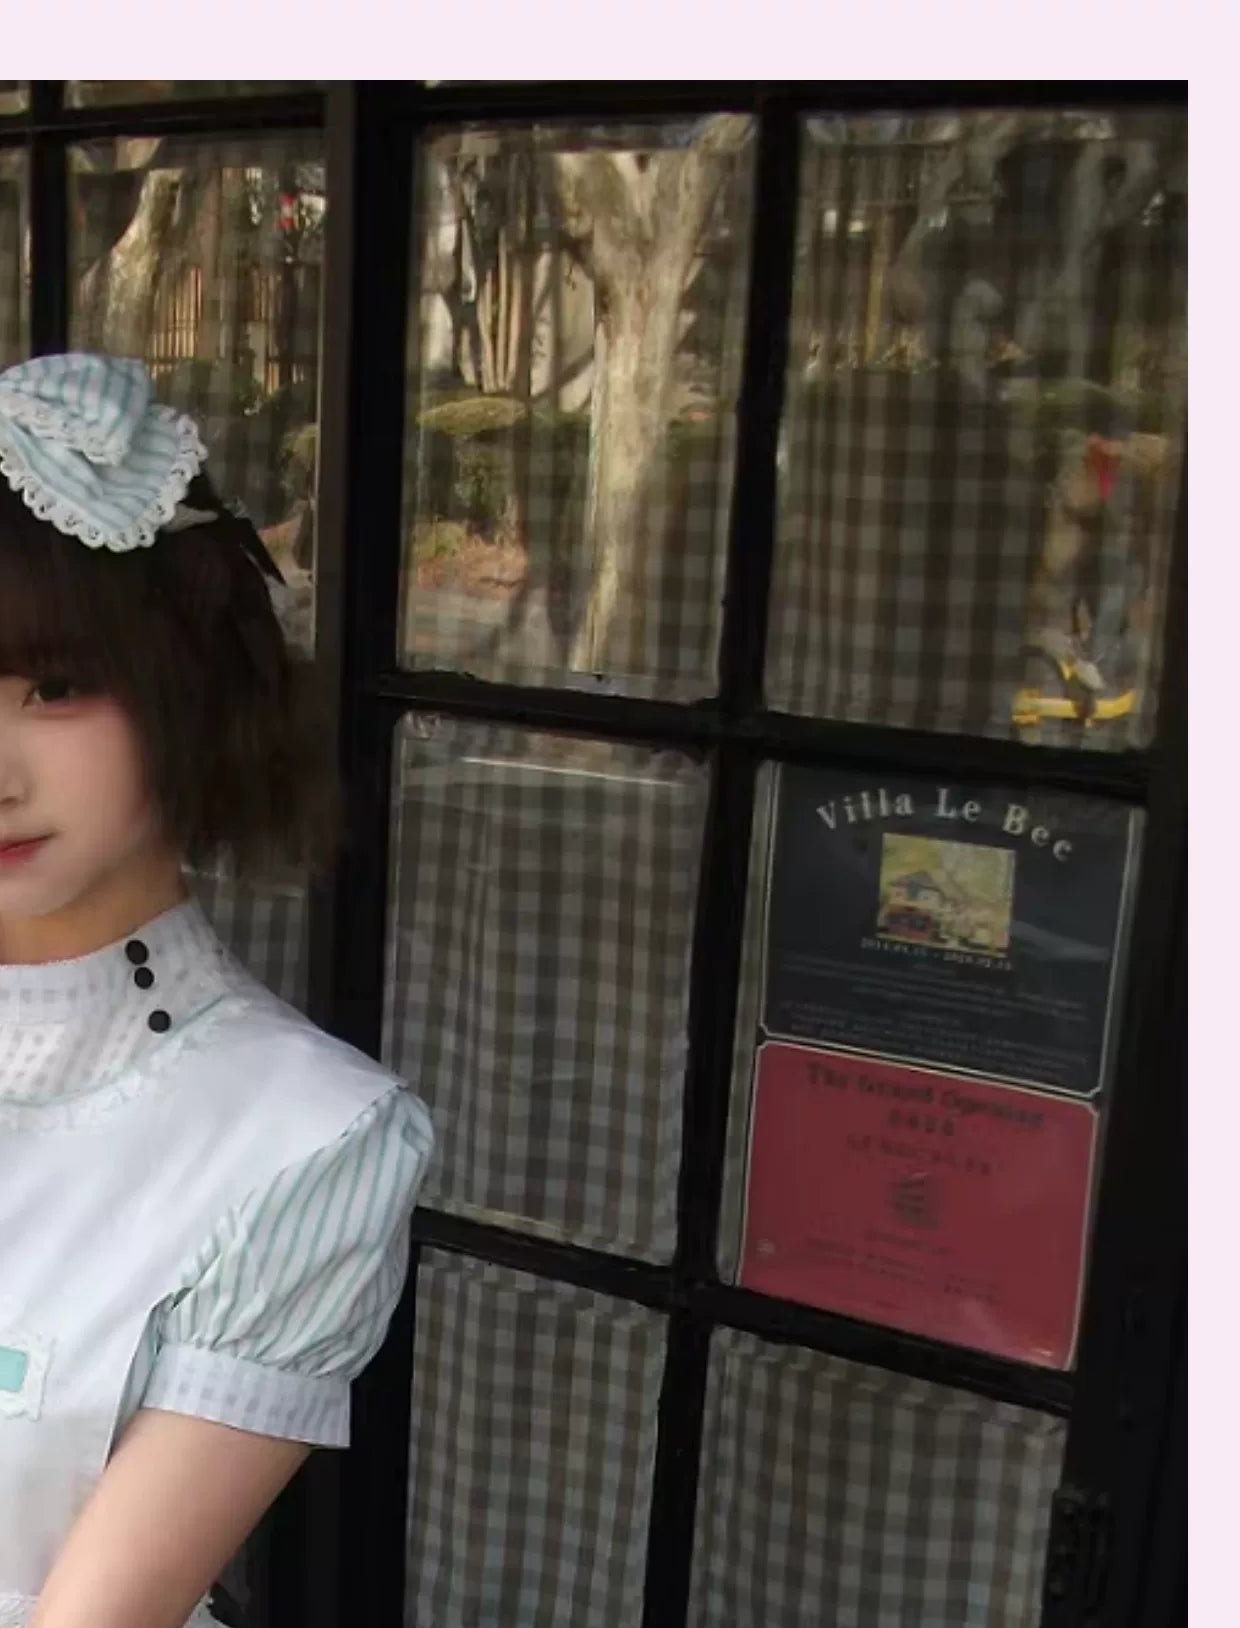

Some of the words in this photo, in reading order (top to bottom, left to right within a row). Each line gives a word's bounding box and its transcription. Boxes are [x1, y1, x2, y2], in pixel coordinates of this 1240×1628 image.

[815, 787, 915, 829] Villa
[934, 787, 982, 823] Le
[1001, 803, 1073, 862] Bec
